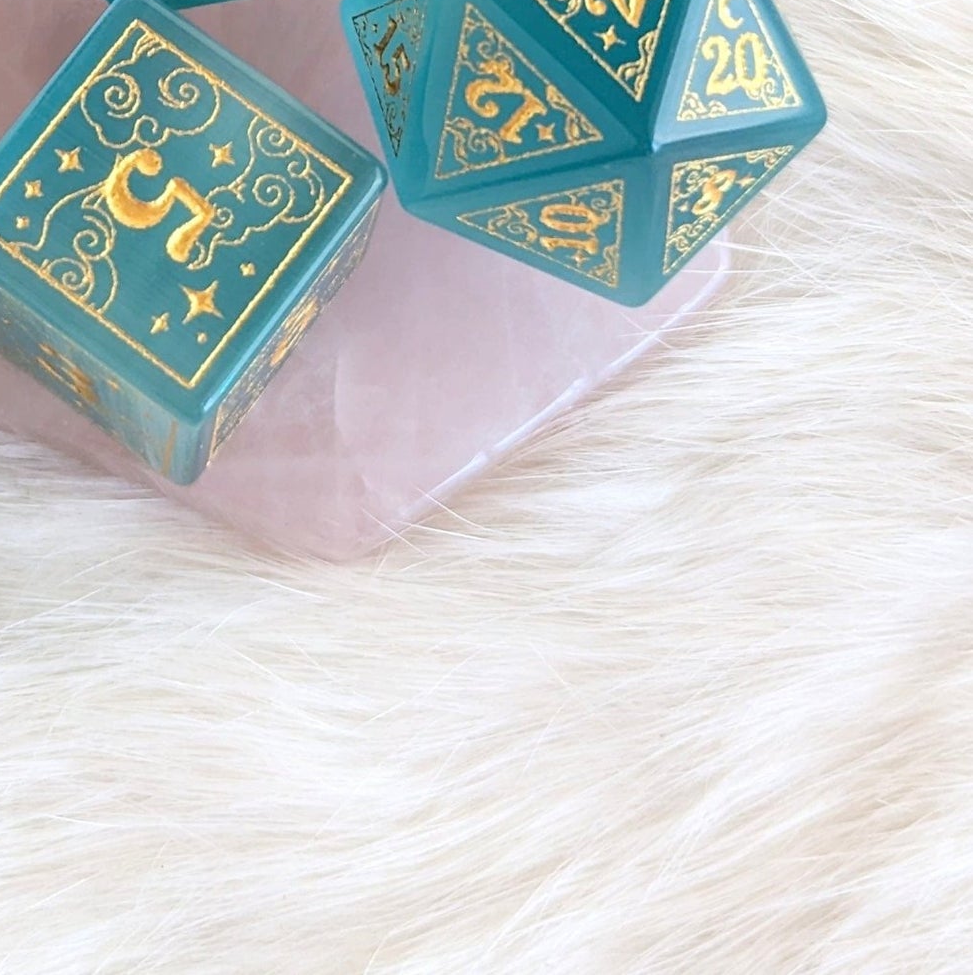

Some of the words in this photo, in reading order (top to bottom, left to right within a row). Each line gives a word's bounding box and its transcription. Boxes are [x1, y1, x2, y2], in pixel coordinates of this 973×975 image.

[465, 58, 548, 145] 12
[701, 35, 767, 96] 20
[105, 147, 215, 264] 5
[539, 200, 600, 256] 10
